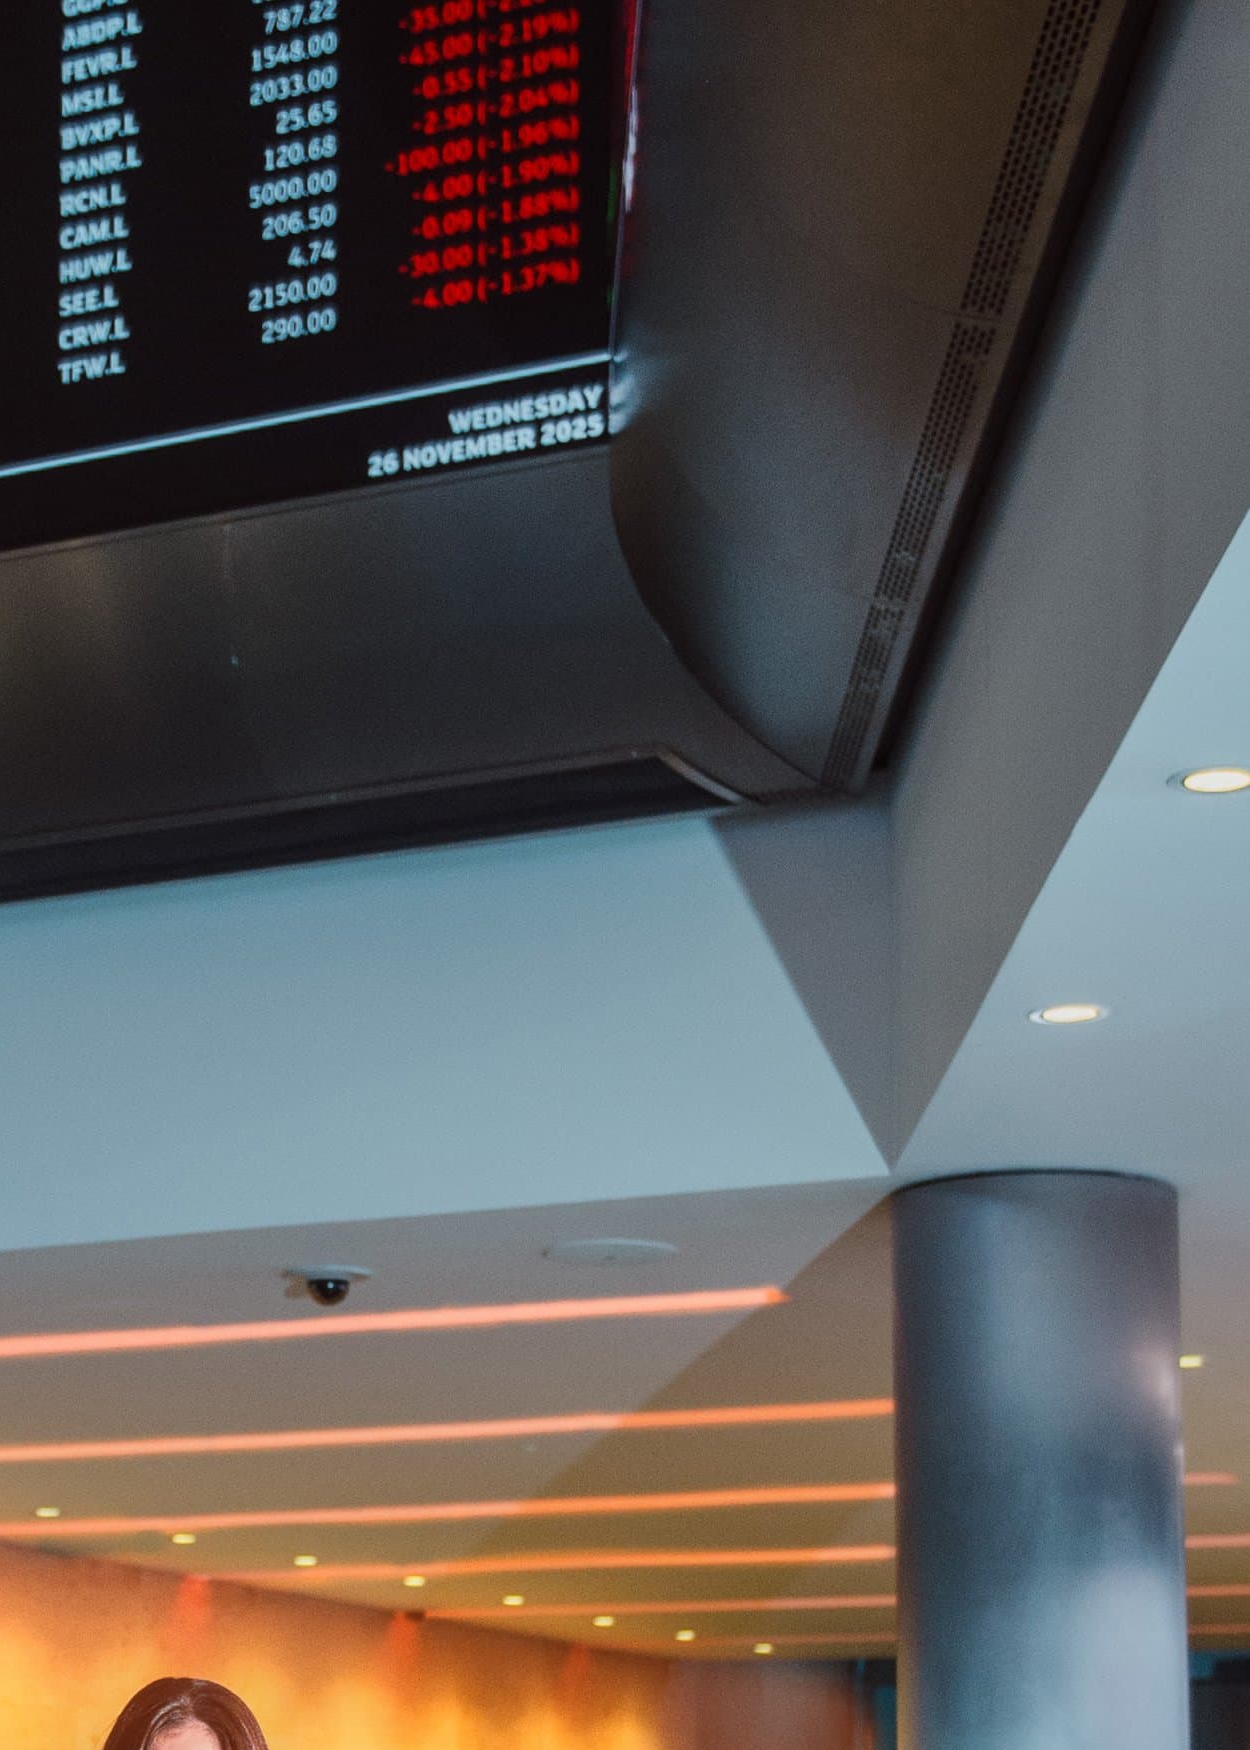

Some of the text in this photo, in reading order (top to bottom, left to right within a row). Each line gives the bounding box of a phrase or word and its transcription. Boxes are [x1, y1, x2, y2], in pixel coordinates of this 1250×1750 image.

[264, 0, 337, 33] 787.22
[252, 30, 337, 71] 1548.00
[250, 65, 337, 105] 2033.00
[276, 100, 337, 134] 25.65
[265, 134, 337, 171] 120.68
[250, 168, 337, 208] 5000.00
[262, 203, 337, 240] 206.50
[288, 240, 336, 266] 4.74
[249, 272, 336, 312] 2150.00
[262, 308, 336, 343] 290.00
[448, 384, 603, 435] WEDNESDAY
[367, 412, 605, 478] 26 NOVEMBER 2025
